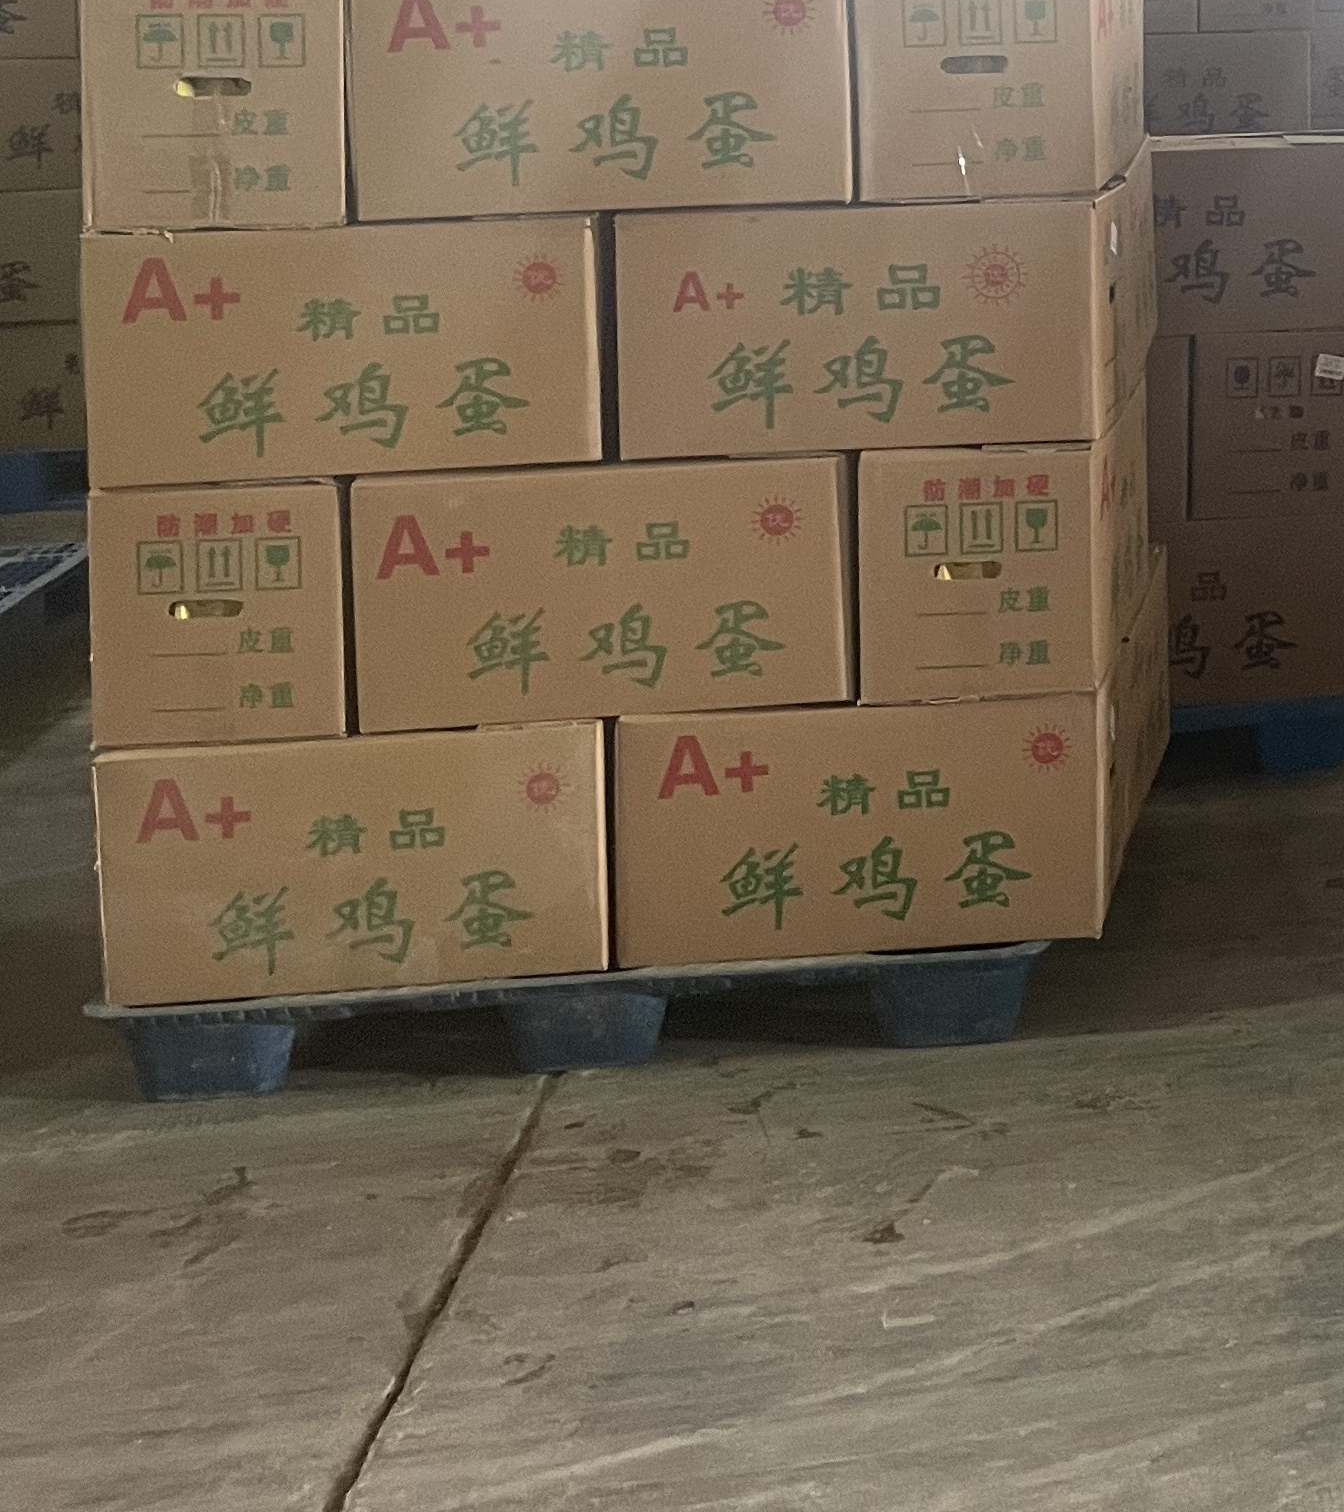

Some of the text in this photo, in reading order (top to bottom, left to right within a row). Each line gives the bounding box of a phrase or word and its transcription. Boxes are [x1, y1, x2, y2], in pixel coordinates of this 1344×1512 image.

[552, 27, 688, 73] 精品
[231, 107, 290, 138] 皮重
[991, 82, 1046, 109] 皮重
[454, 91, 777, 187] 鲜鸡蛋
[233, 163, 292, 193] 净重
[122, 256, 441, 342] A+ 精品
[672, 263, 941, 316] A+ 精品
[198, 357, 530, 458] 鲜鸡蛋
[707, 333, 1016, 430] 鲜鸡蛋
[376, 514, 691, 580] A+ 精品
[999, 586, 1052, 614] 皮重
[238, 625, 295, 655] 皮重
[466, 600, 786, 697] 鲜鸡蛋
[999, 639, 1052, 667] 净重
[238, 681, 296, 710] 净重
[657, 734, 952, 816] A+ 精品
[136, 778, 447, 857] A+ 精品
[719, 830, 1032, 931] 鲜鸡蛋
[210, 869, 535, 976] 鲜鸡蛋
